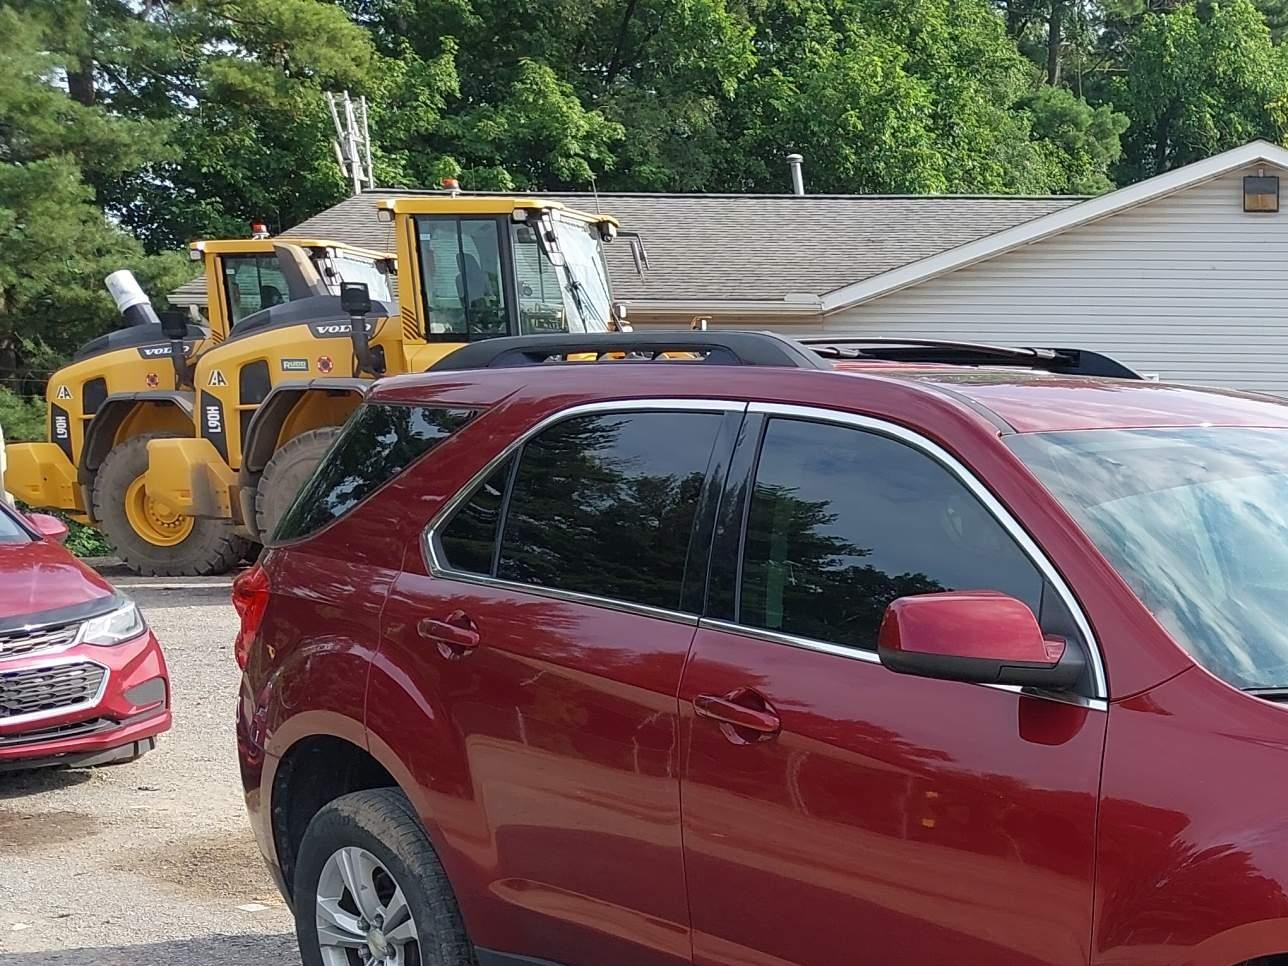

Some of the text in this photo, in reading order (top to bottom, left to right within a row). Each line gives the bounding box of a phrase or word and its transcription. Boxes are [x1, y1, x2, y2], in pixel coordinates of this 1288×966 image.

[316, 324, 371, 334] VOLO
[55, 416, 68, 439] L90H
[206, 406, 222, 433] L90H
